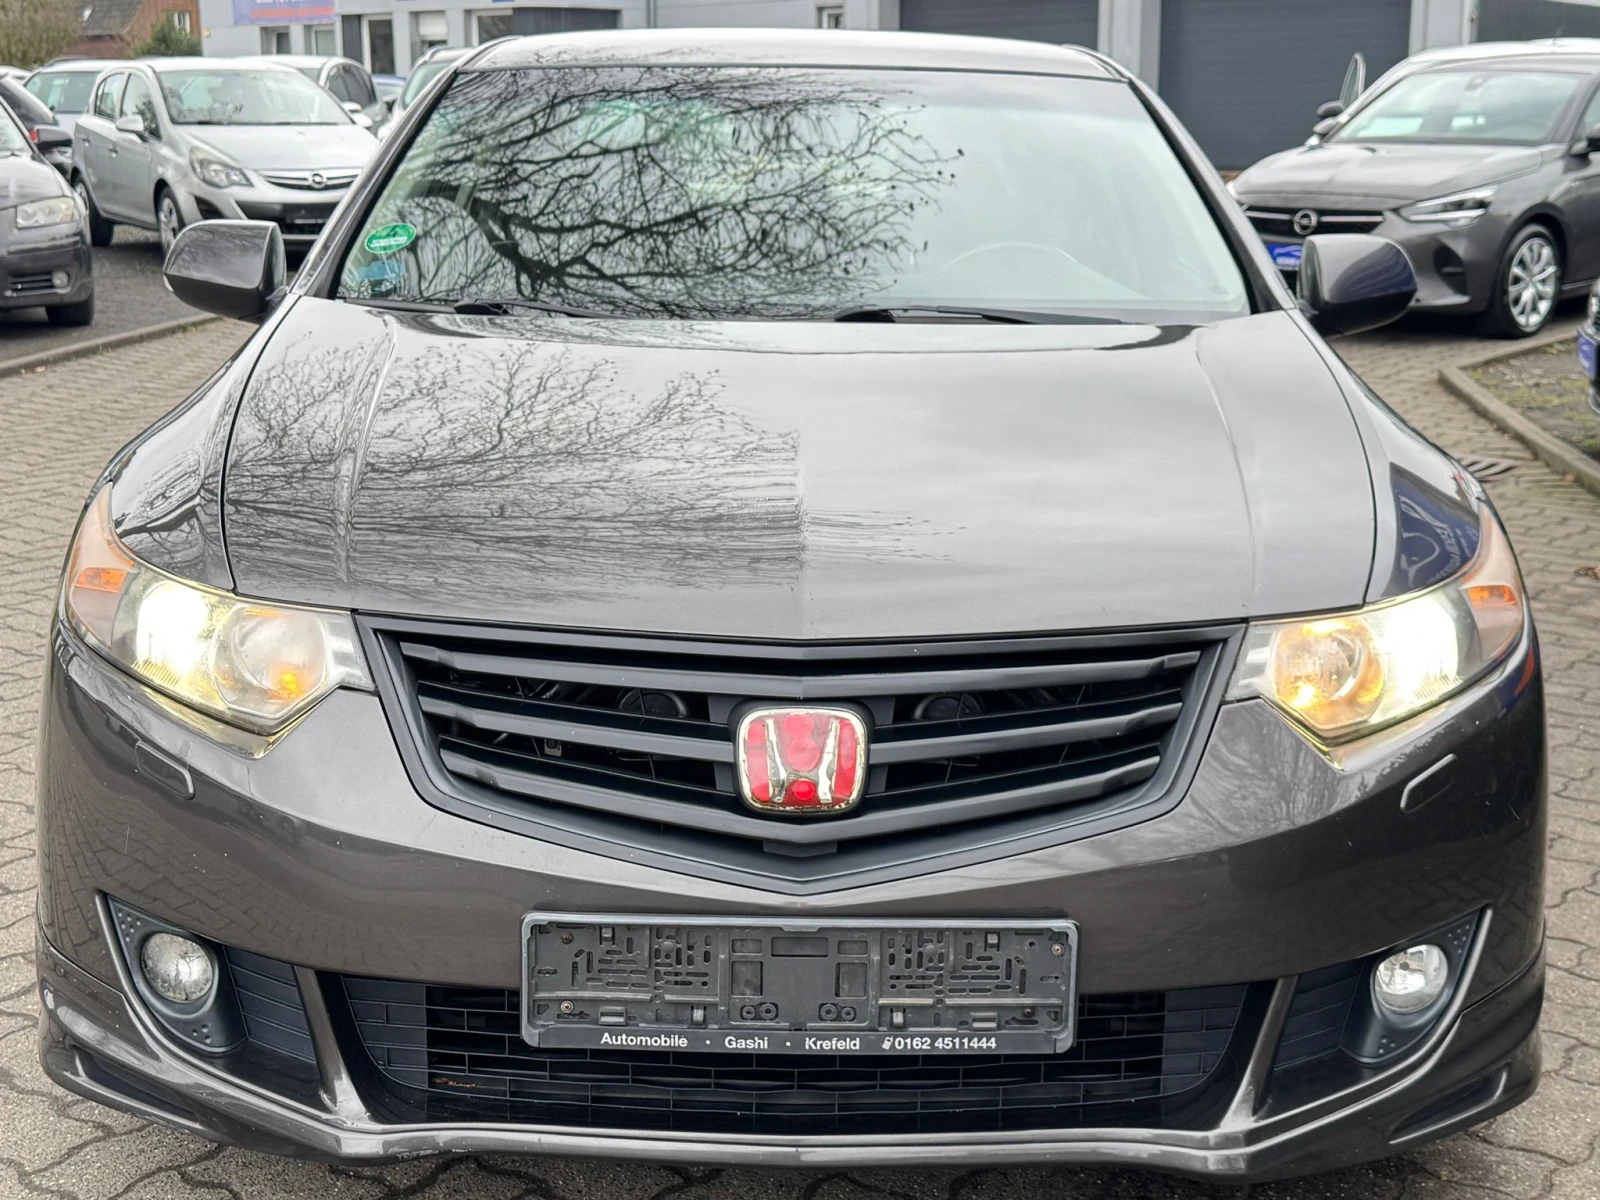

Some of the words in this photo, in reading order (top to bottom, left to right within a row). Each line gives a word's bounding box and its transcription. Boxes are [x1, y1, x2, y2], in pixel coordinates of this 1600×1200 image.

[600, 1033, 688, 1047] Automobile
[724, 1036, 769, 1049] Gashi
[804, 1037, 860, 1050] Krefeld
[894, 1037, 931, 1050] 0162
[935, 1037, 997, 1050] 4511444
